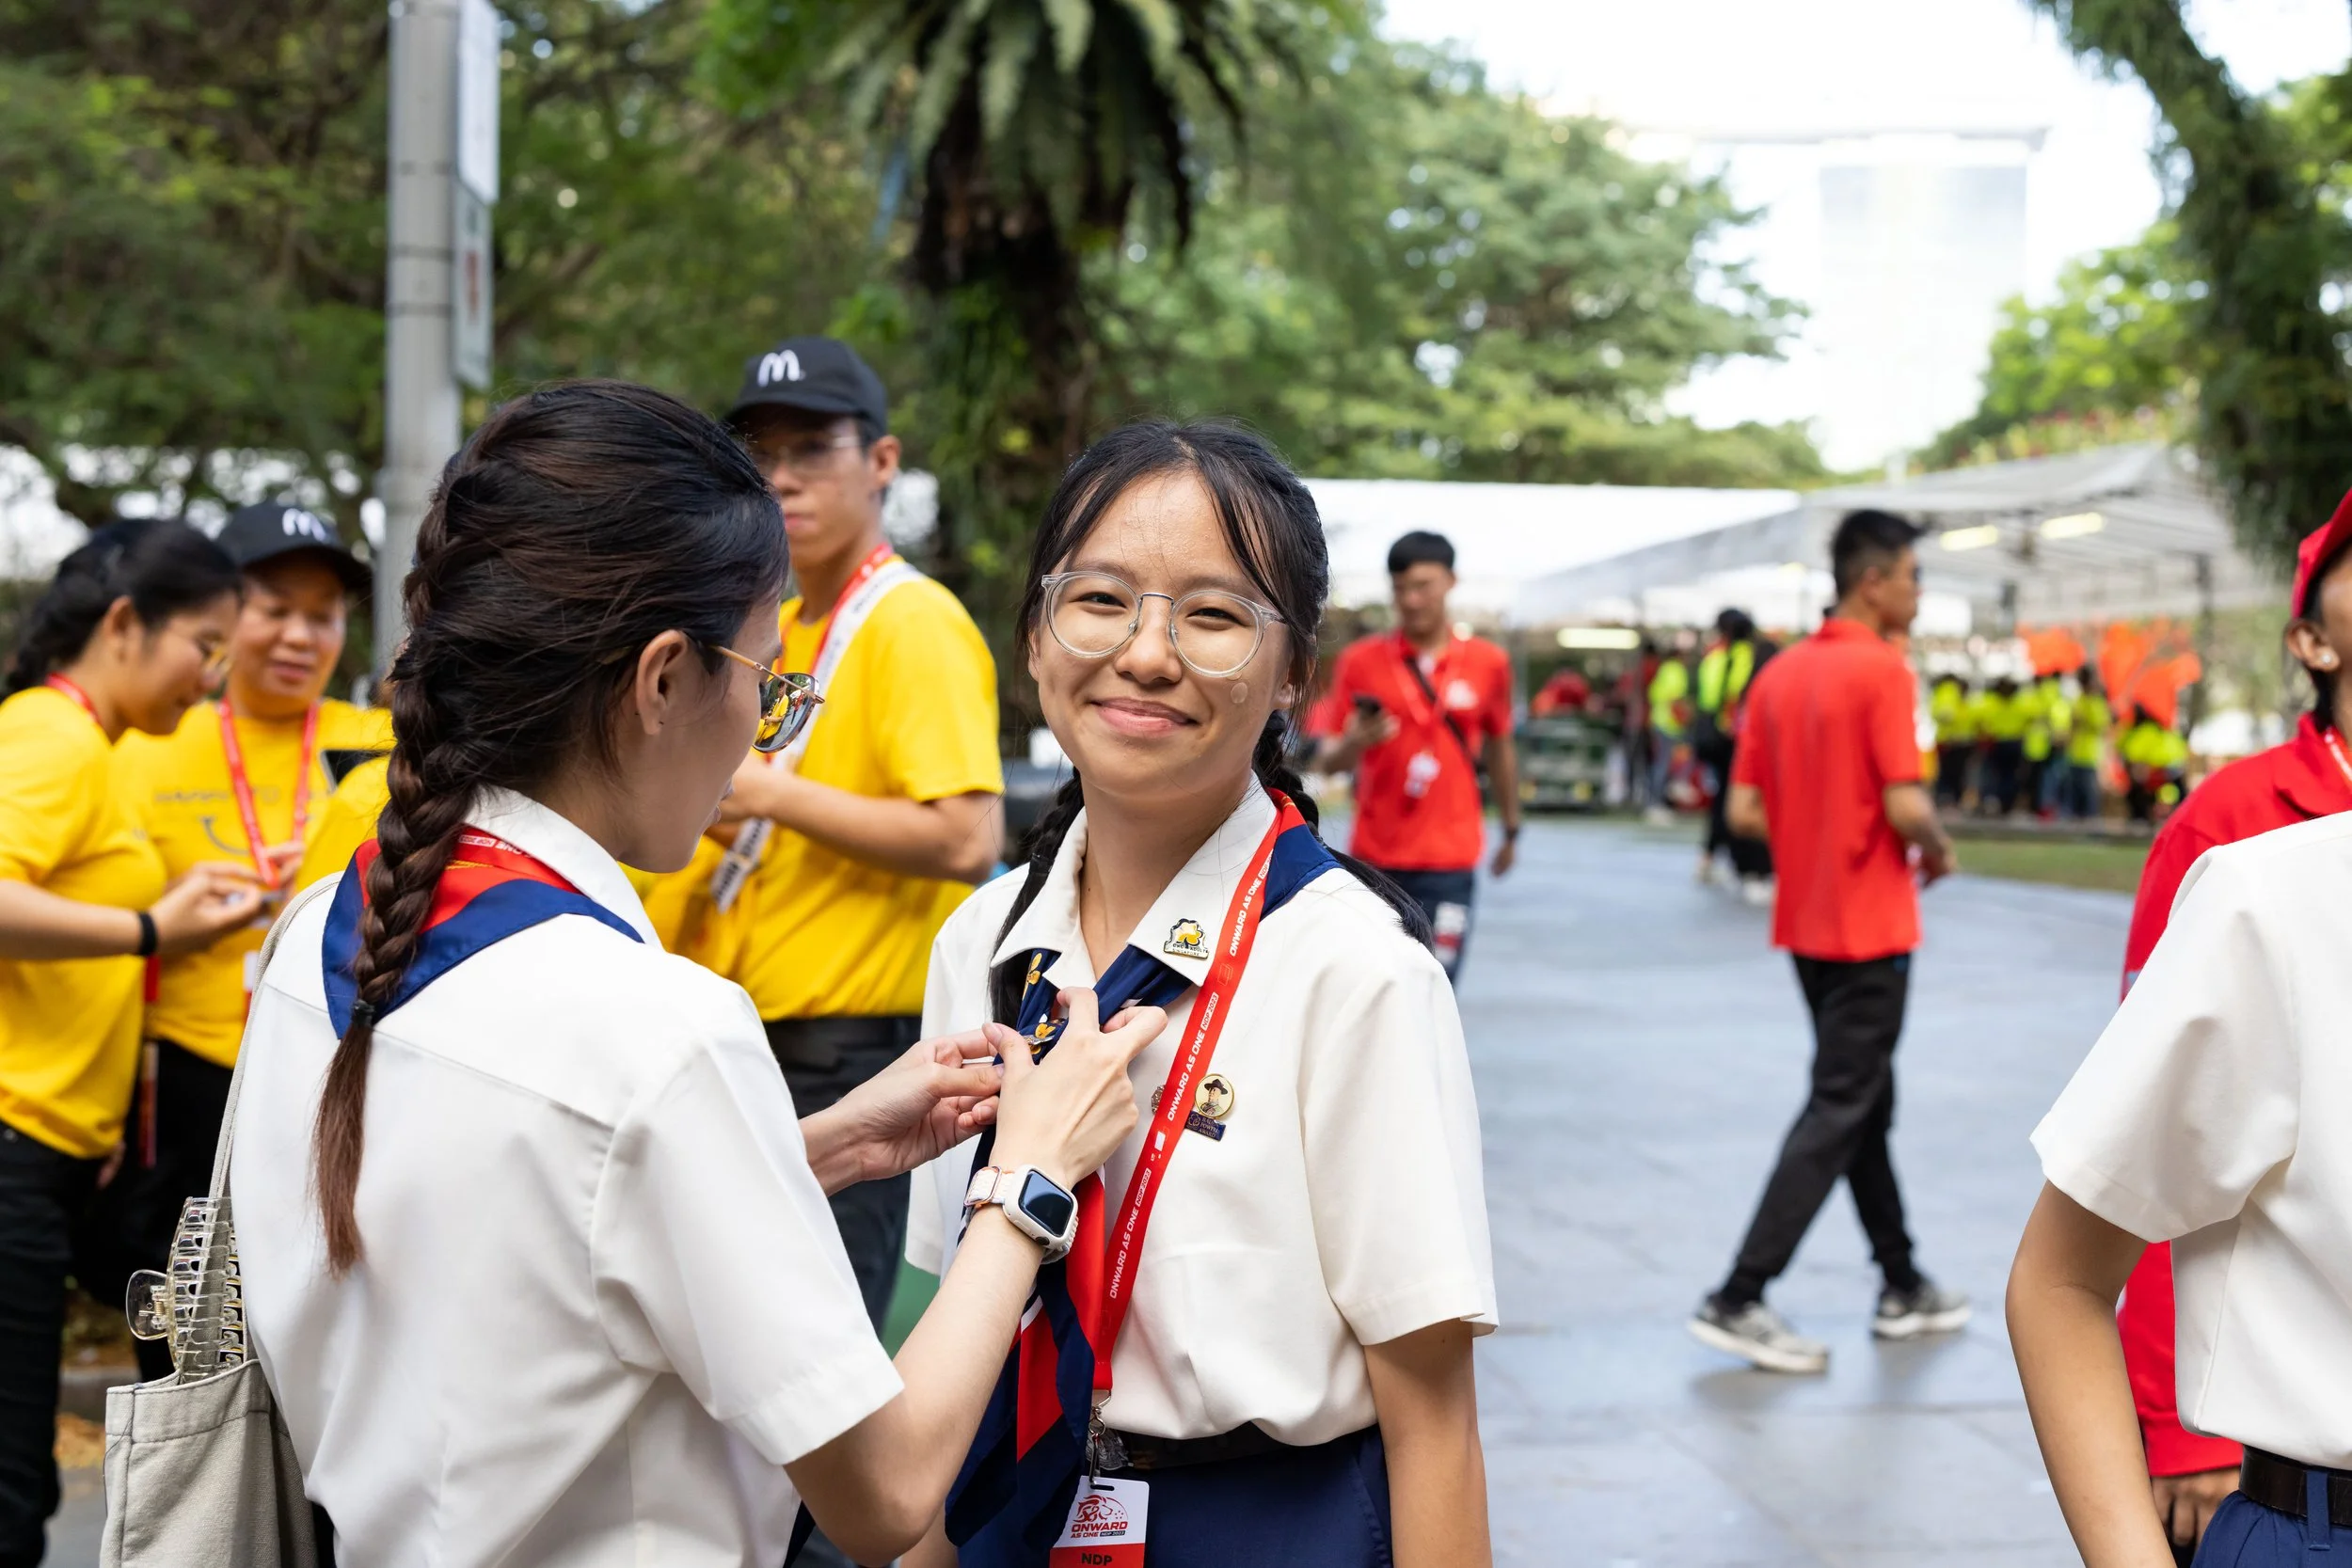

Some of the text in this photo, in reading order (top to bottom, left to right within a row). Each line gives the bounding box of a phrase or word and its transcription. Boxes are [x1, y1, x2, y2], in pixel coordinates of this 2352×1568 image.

[1229, 910, 1247, 957] ONWARD
[1242, 895, 1252, 910] AS
[1248, 878, 1262, 895] ONE
[1167, 994, 1218, 1121] ONWARD AS ONE NDP 2023
[1109, 1250, 1127, 1299] ONWARD
[1121, 1232, 1131, 1250] AS
[1126, 1207, 1139, 1232] ONE
[1071, 1521, 1128, 1532] ONWARD
[1081, 1552, 1113, 1567] NDP
